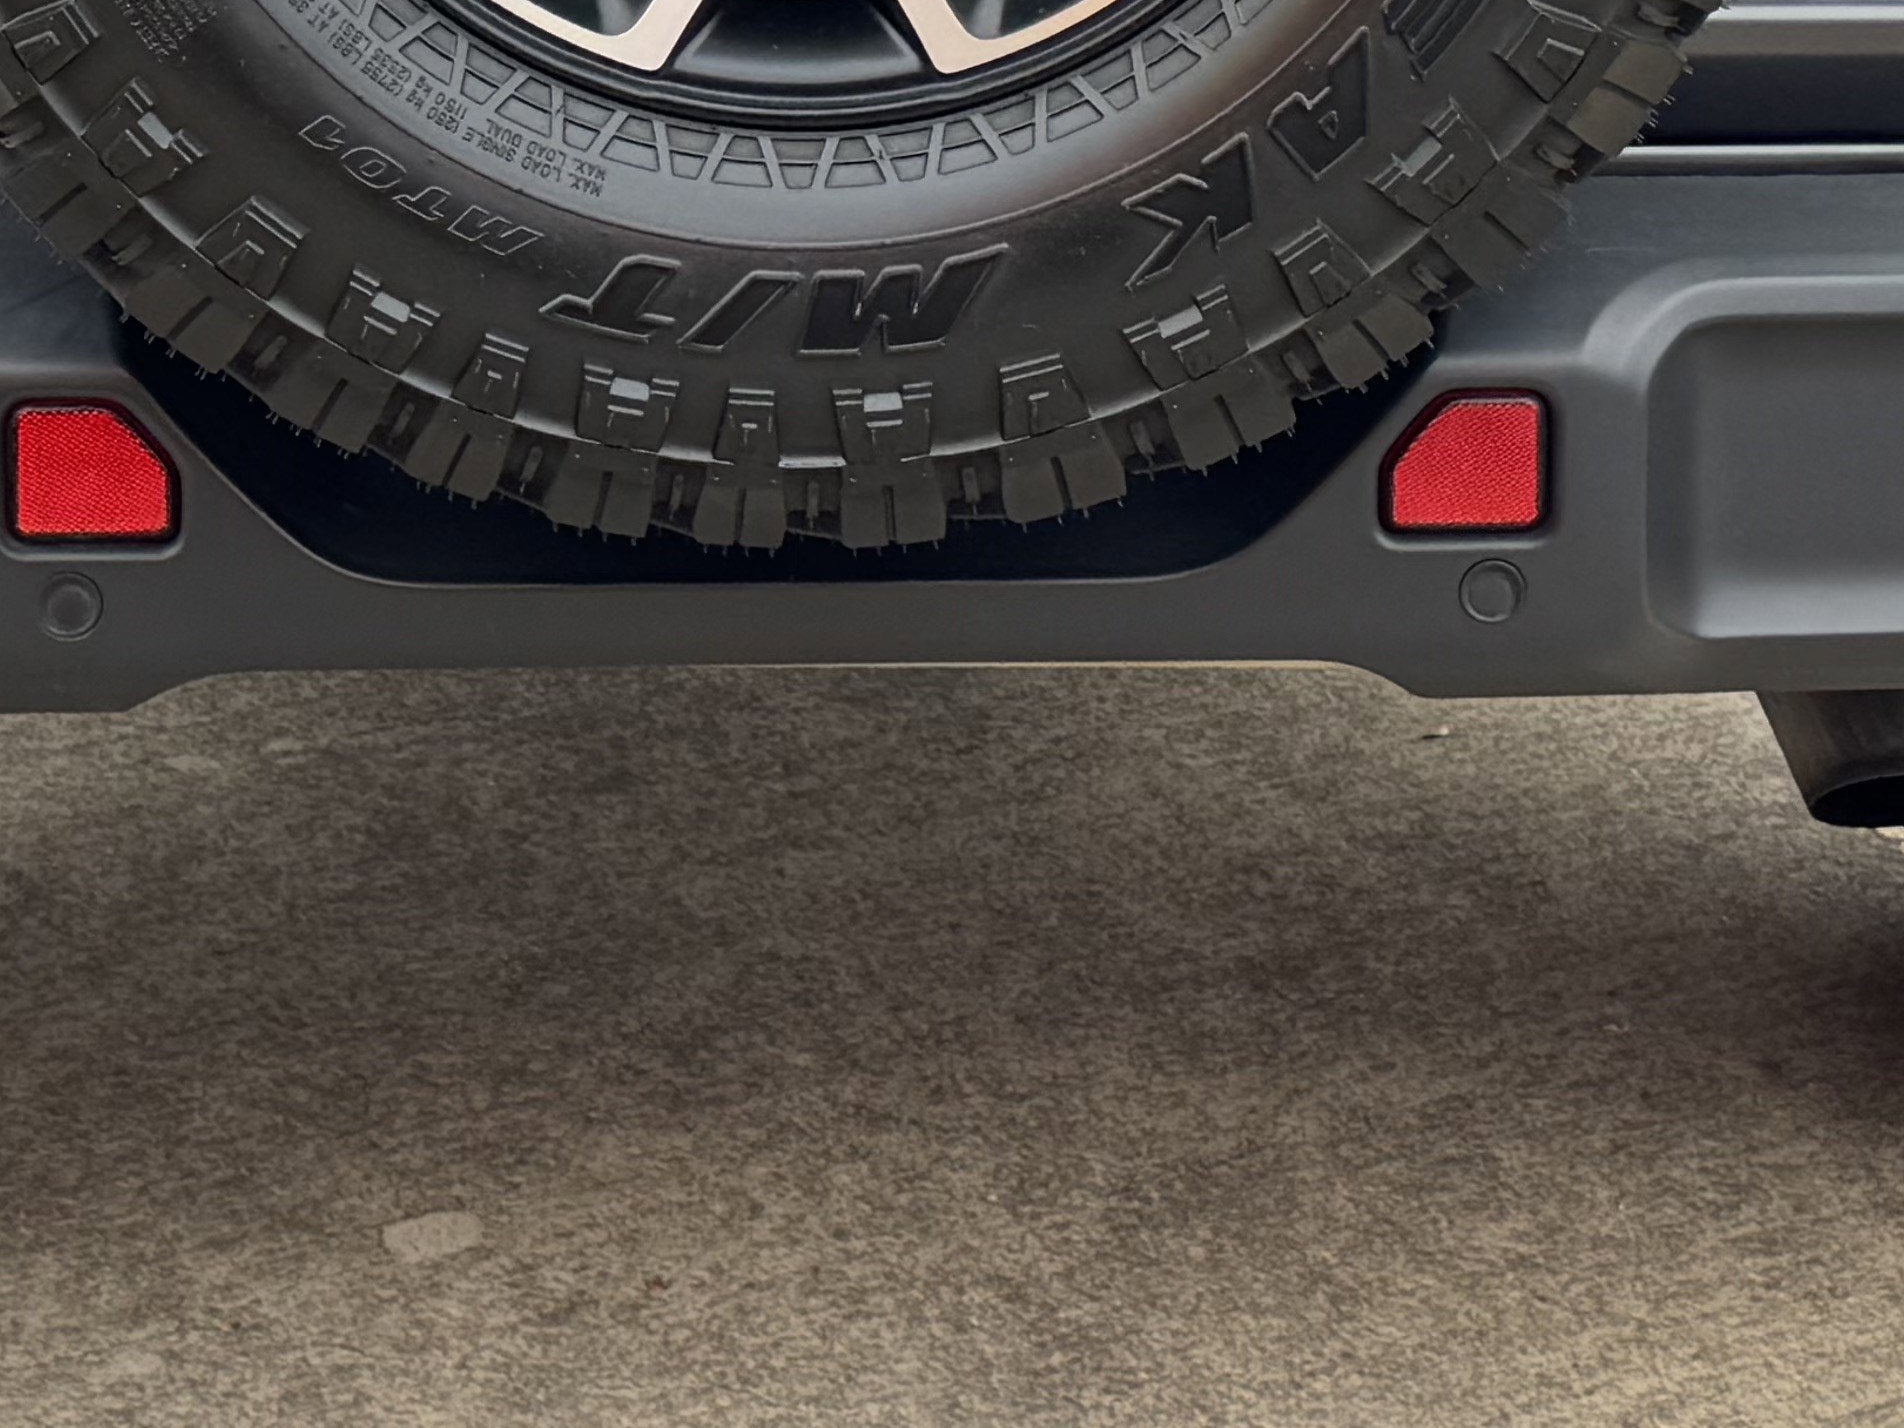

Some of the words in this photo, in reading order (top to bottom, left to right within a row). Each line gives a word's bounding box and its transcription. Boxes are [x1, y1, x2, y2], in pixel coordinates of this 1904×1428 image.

[304, 10, 330, 35] AT
[460, 125, 518, 164] SINGLE
[480, 117, 525, 149] DUAL
[518, 153, 563, 183] LOAD
[524, 138, 569, 168] LOAD
[296, 105, 544, 267] MT01
[539, 243, 1010, 356] M/T
